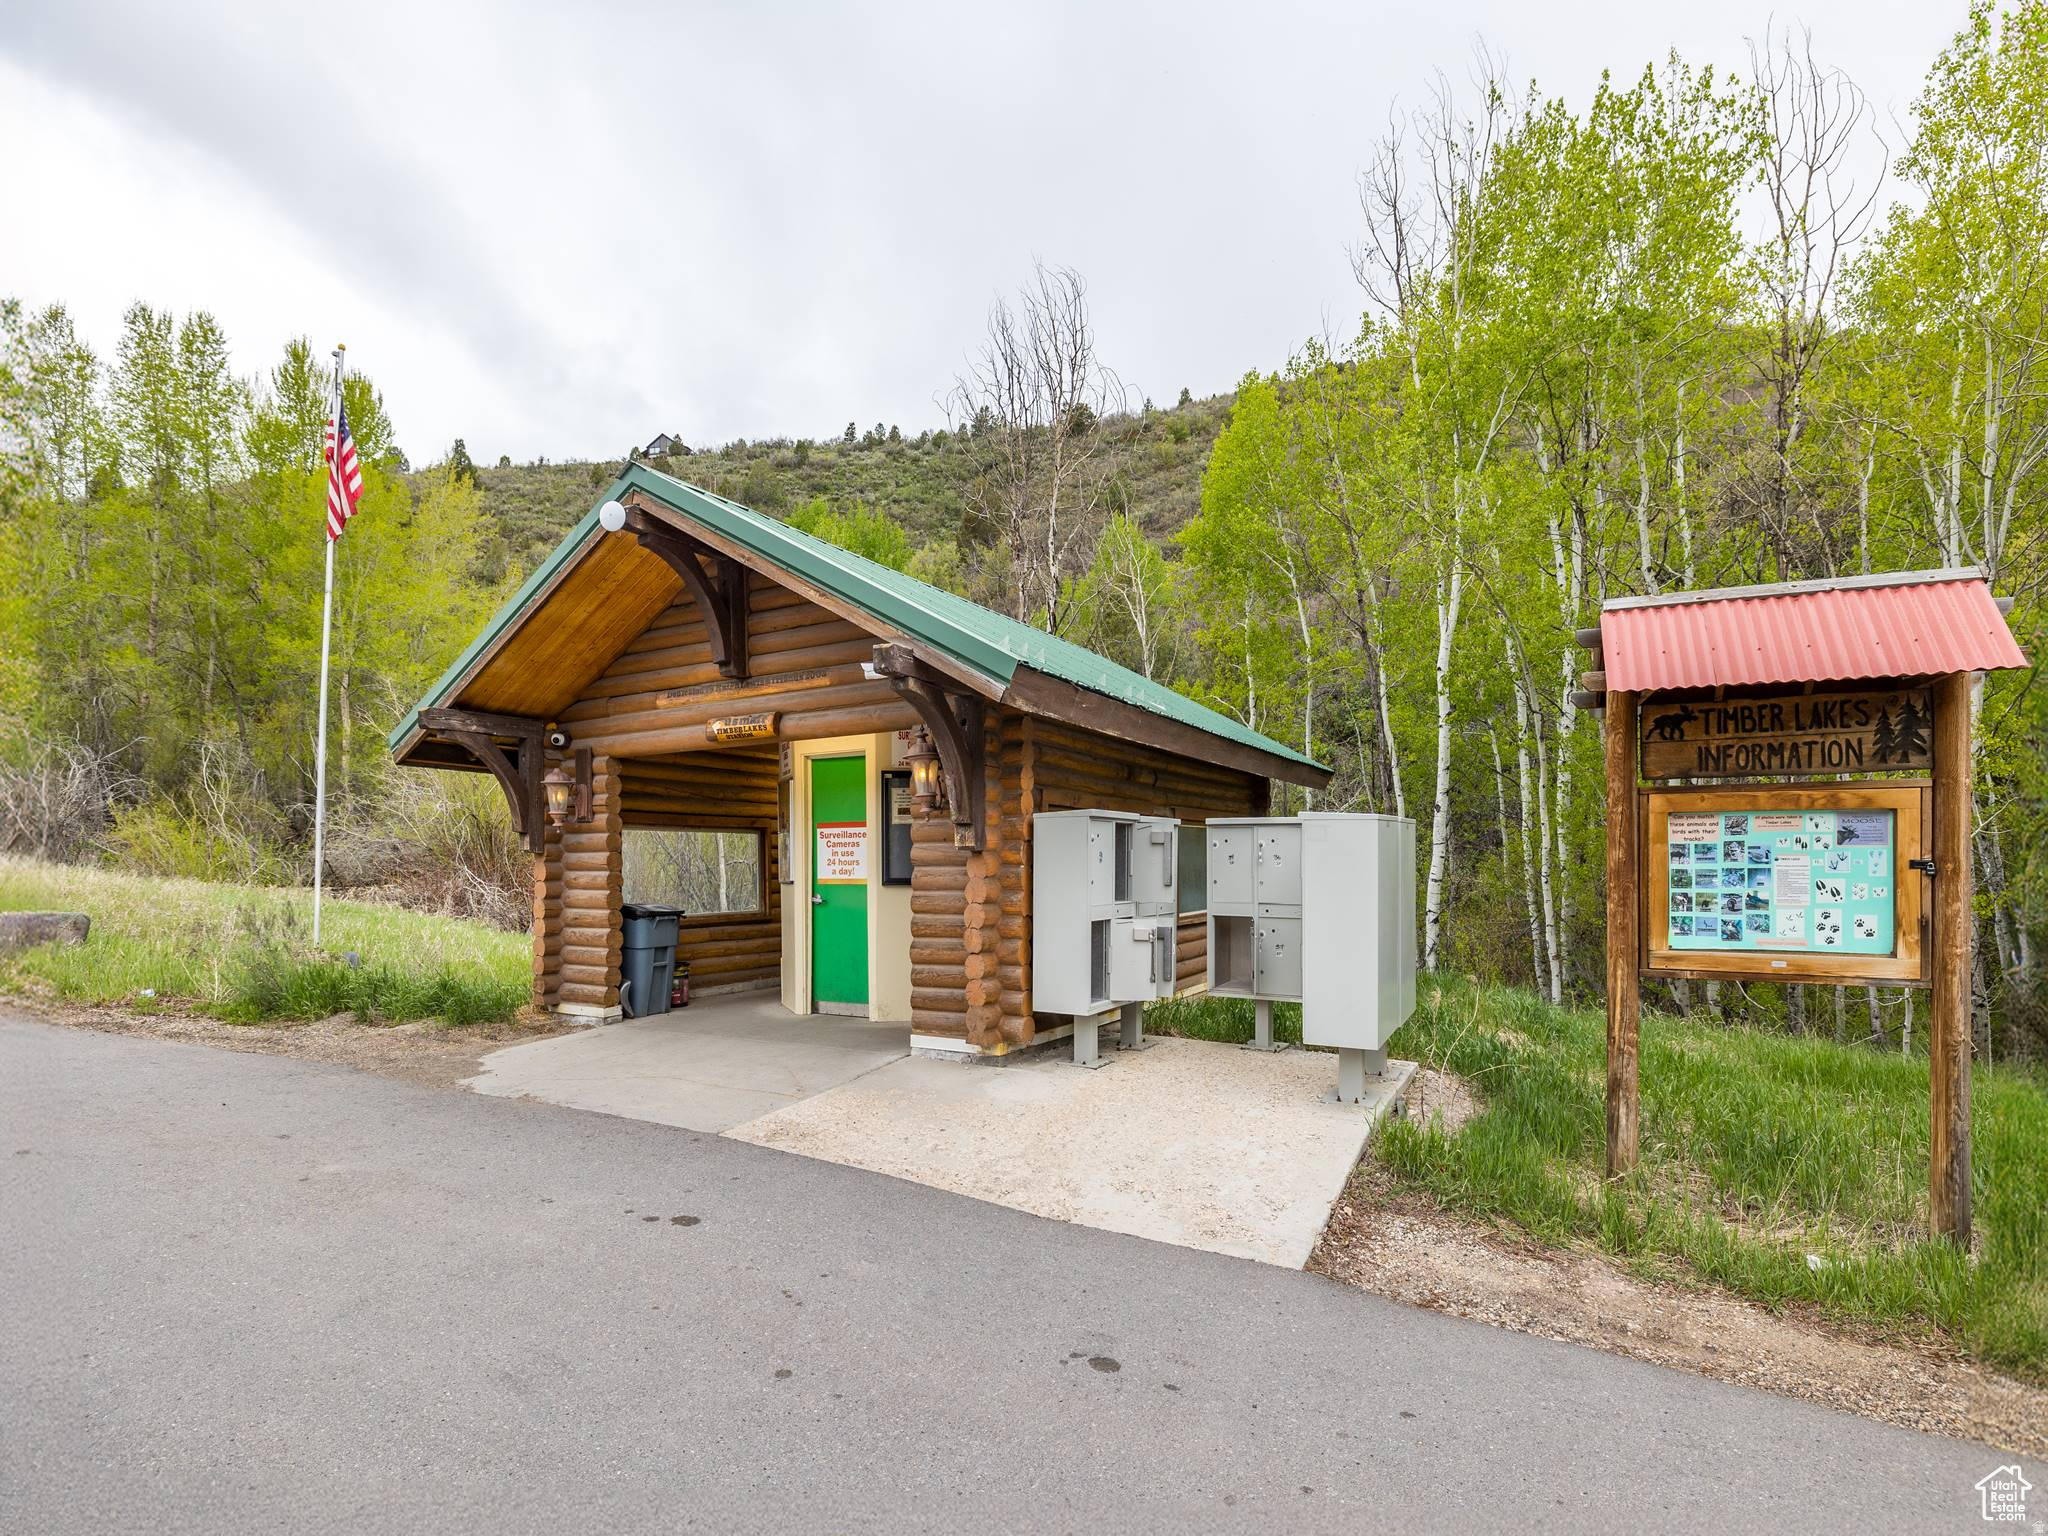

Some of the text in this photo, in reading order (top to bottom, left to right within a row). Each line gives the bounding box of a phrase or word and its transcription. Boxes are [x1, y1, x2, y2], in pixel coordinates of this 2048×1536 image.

[1698, 700, 1869, 735] TIMBER LAKES
[1697, 737, 1864, 773] INFORMATION
[819, 831, 867, 840] Surveillance
[826, 840, 861, 848] Cameras
[831, 849, 839, 857] in
[827, 858, 861, 866] 24 hours
[838, 867, 855, 877] day!
